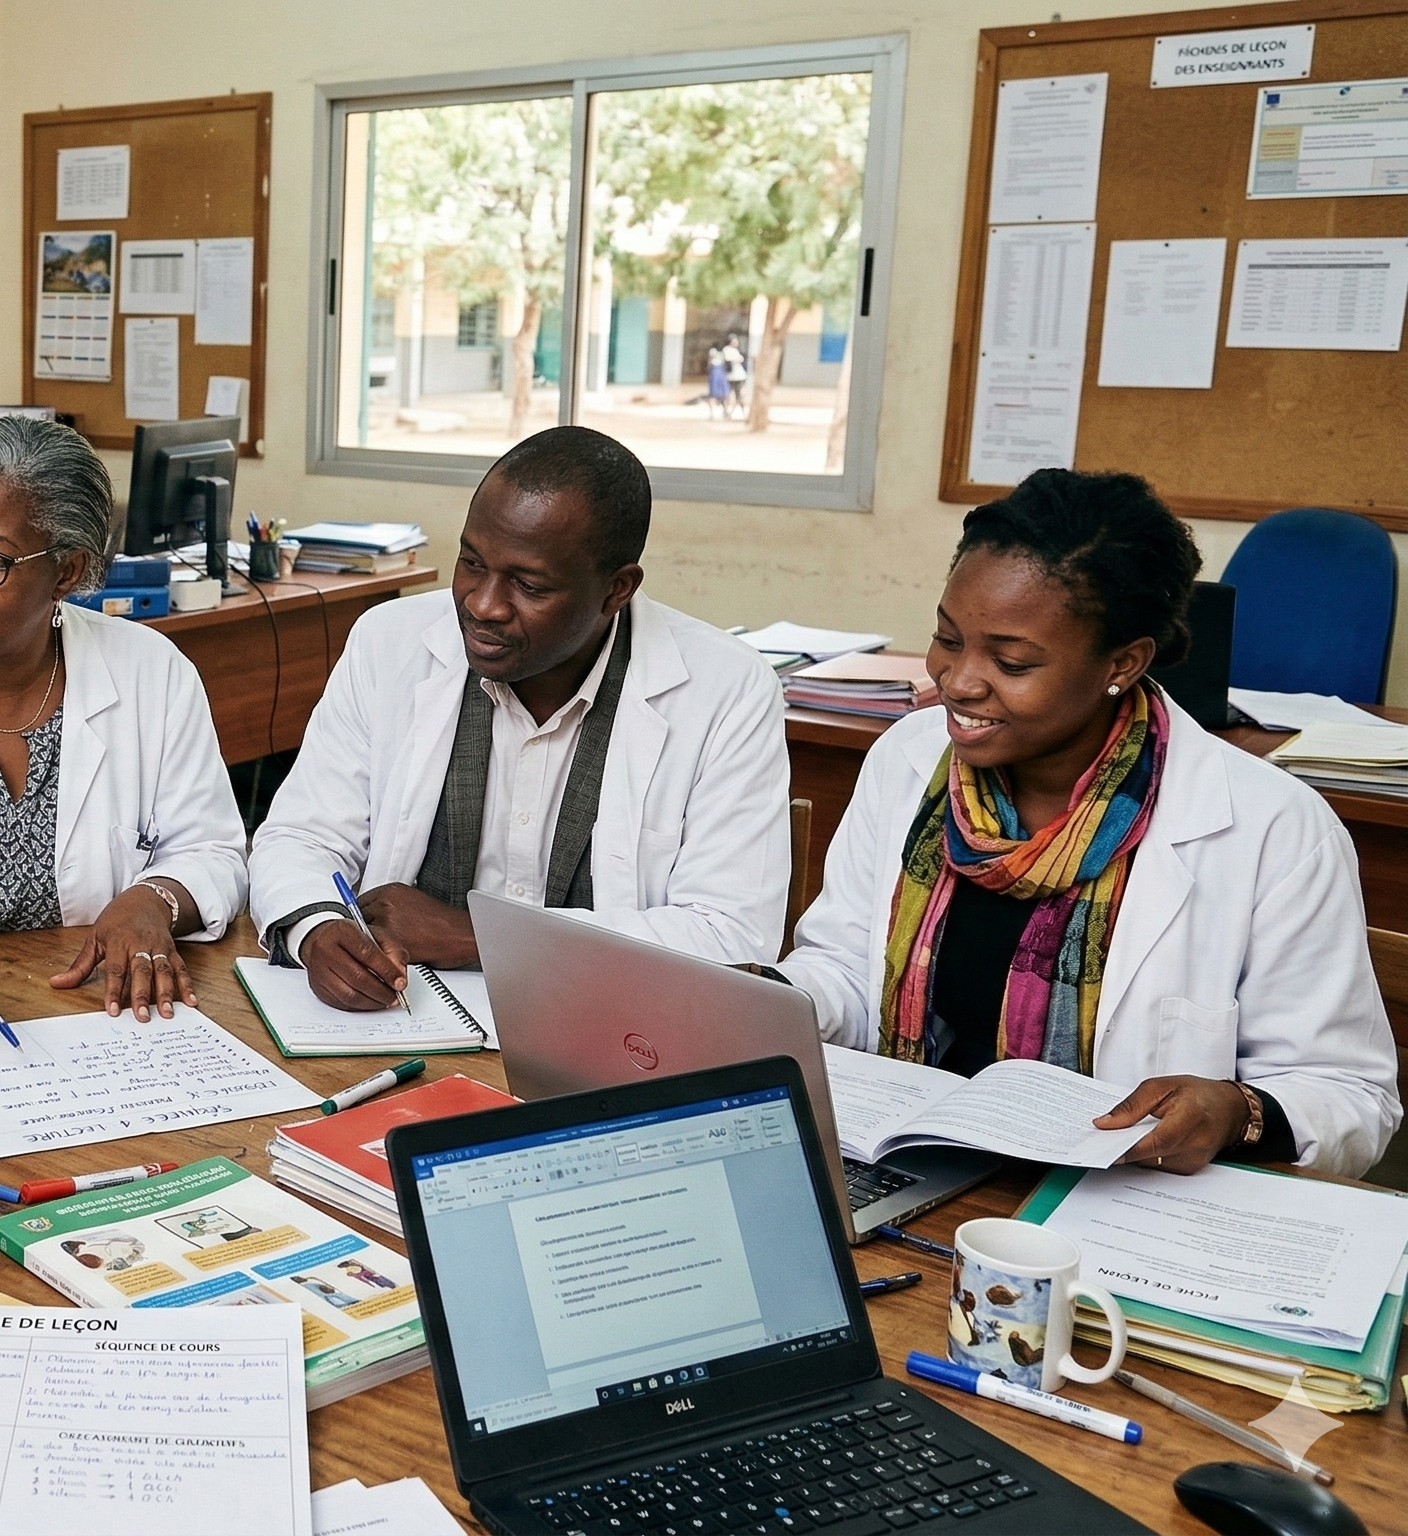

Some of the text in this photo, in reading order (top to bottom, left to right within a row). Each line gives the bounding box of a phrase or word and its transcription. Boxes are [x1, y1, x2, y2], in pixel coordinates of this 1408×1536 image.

[1231, 42, 1247, 54] DE
[1249, 40, 1287, 53] LEÇON
[1174, 64, 1195, 75] DES
[22, 1123, 106, 1143] LECTURE
[18, 1317, 46, 1329] DE
[51, 1318, 118, 1334] LEÇON
[160, 1343, 176, 1352] DE
[178, 1343, 221, 1352] COURS
[665, 1398, 695, 1415] DELL
